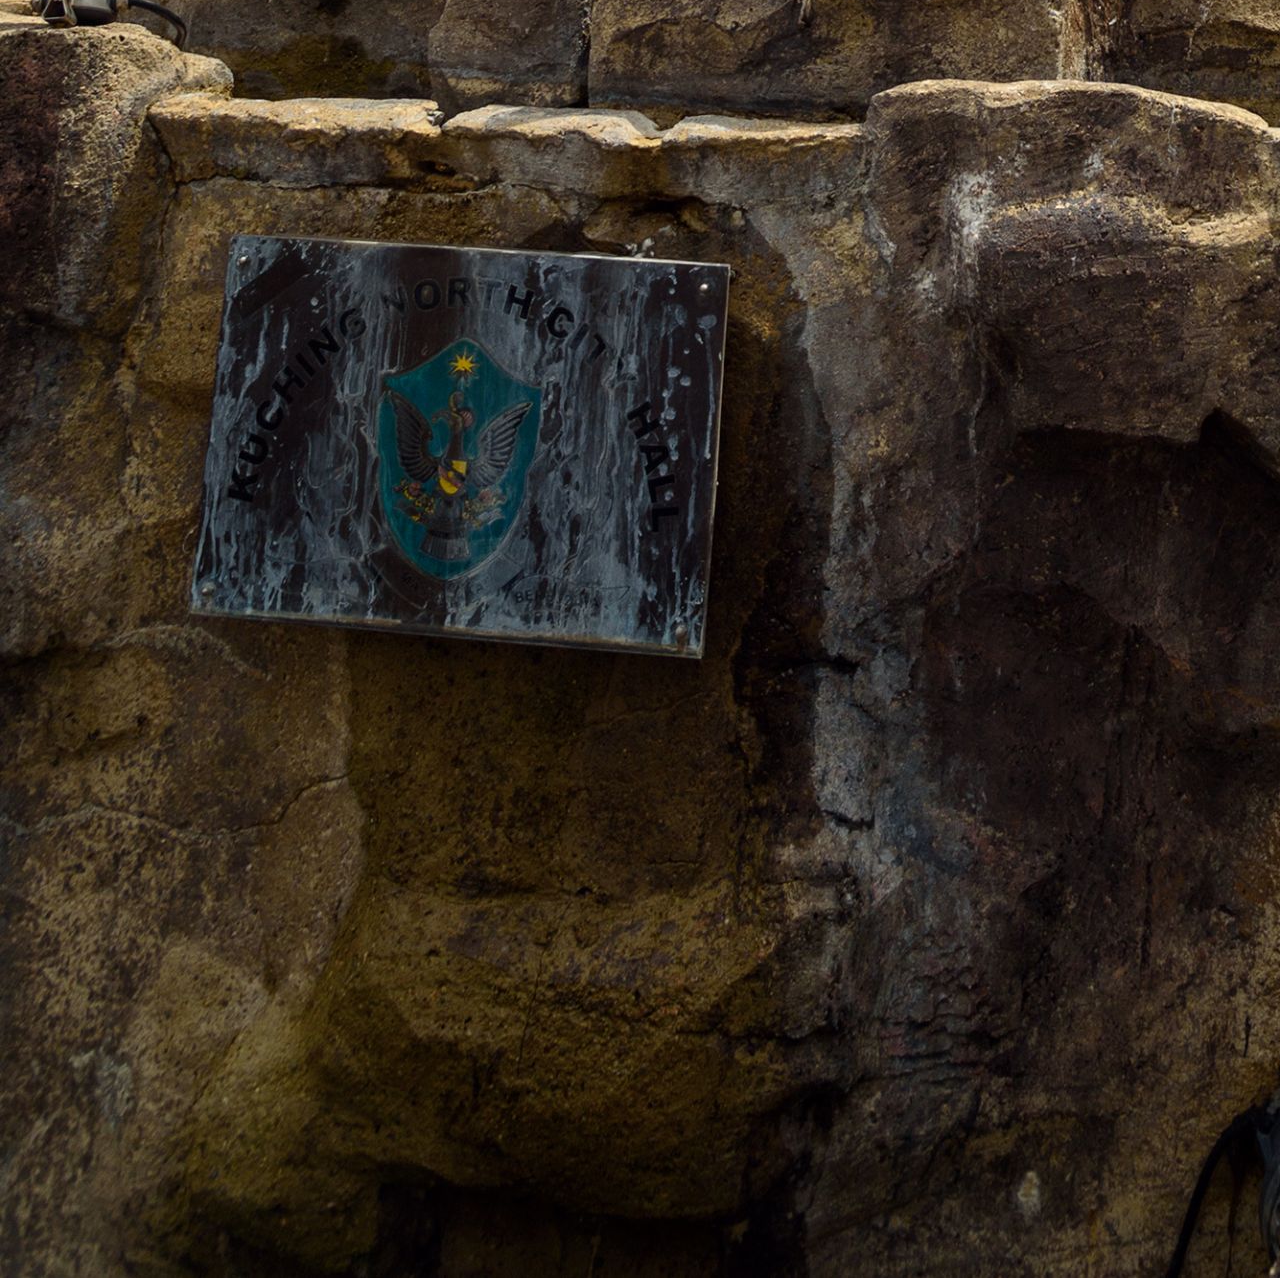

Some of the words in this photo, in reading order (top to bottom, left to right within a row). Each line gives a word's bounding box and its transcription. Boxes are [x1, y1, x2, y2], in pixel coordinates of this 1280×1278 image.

[227, 308, 369, 504] KUCHING
[383, 275, 537, 323] NORTH
[627, 401, 683, 533] HALL
